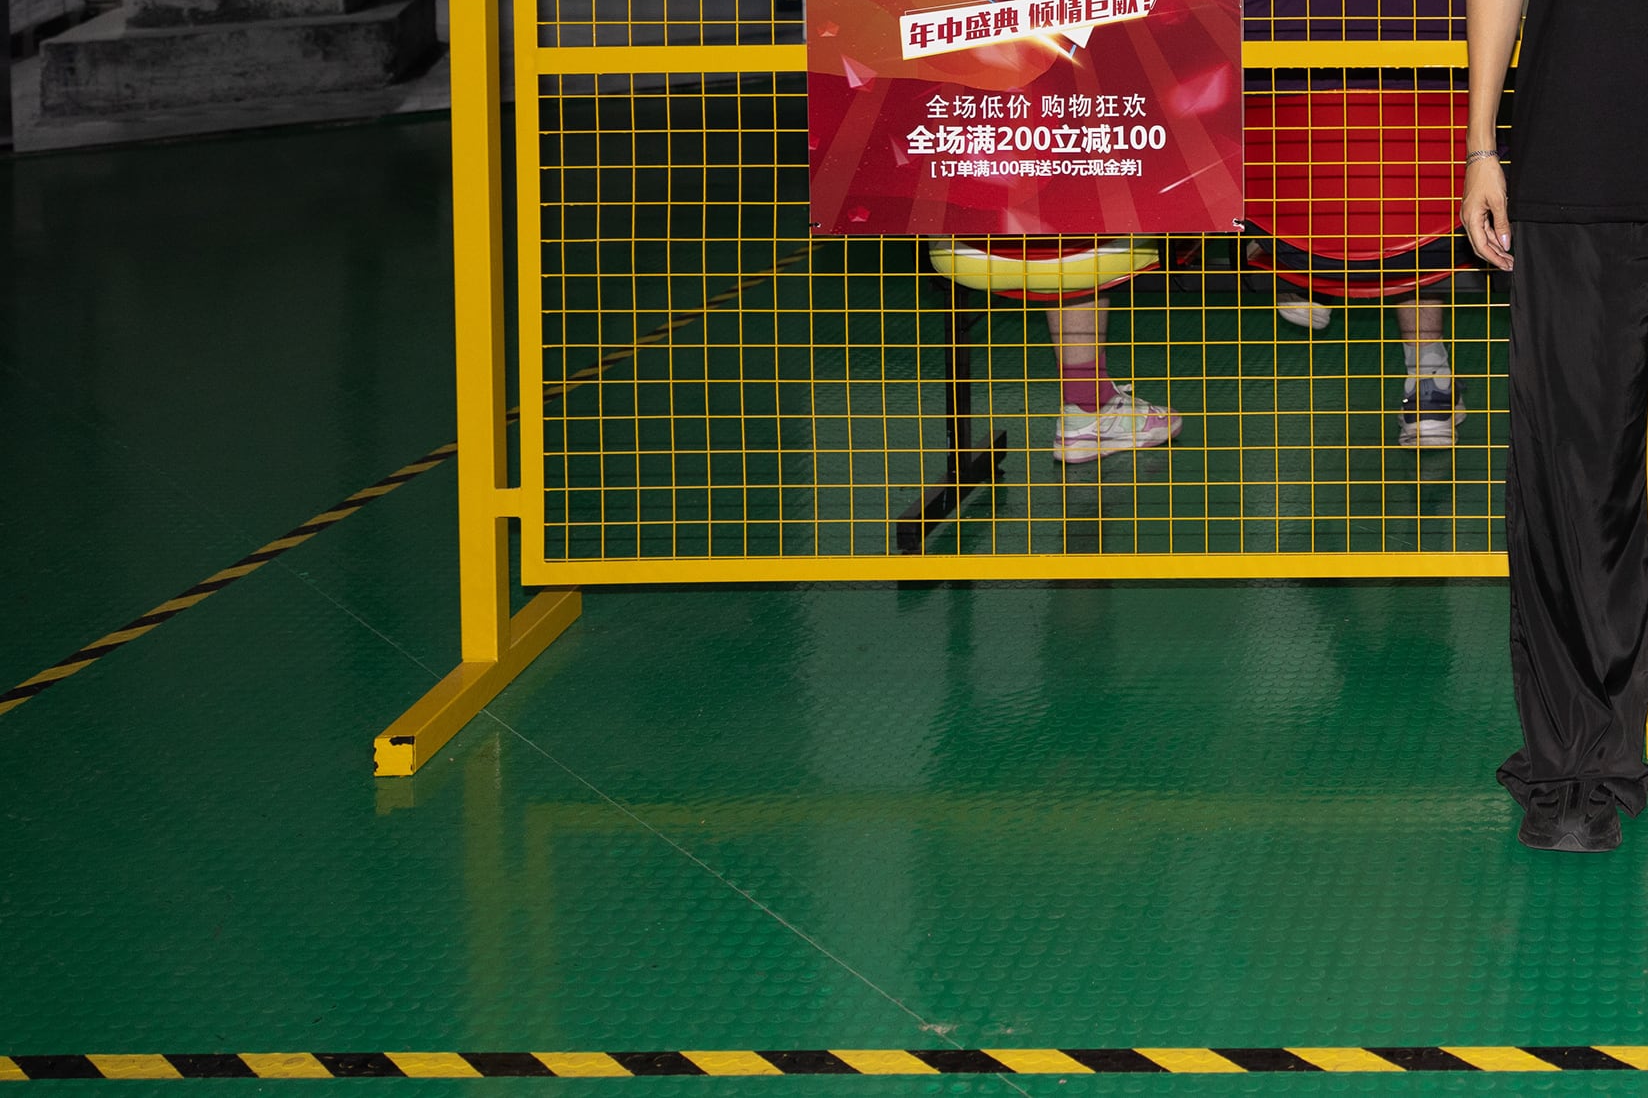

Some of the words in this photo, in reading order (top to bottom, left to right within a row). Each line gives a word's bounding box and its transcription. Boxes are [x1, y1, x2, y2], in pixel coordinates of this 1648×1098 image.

[908, 6, 1019, 49] 年中盛典
[926, 94, 1031, 119] 全场低价
[1041, 93, 1147, 119] 购物狂欢
[906, 124, 1166, 155] 全场满200立减100
